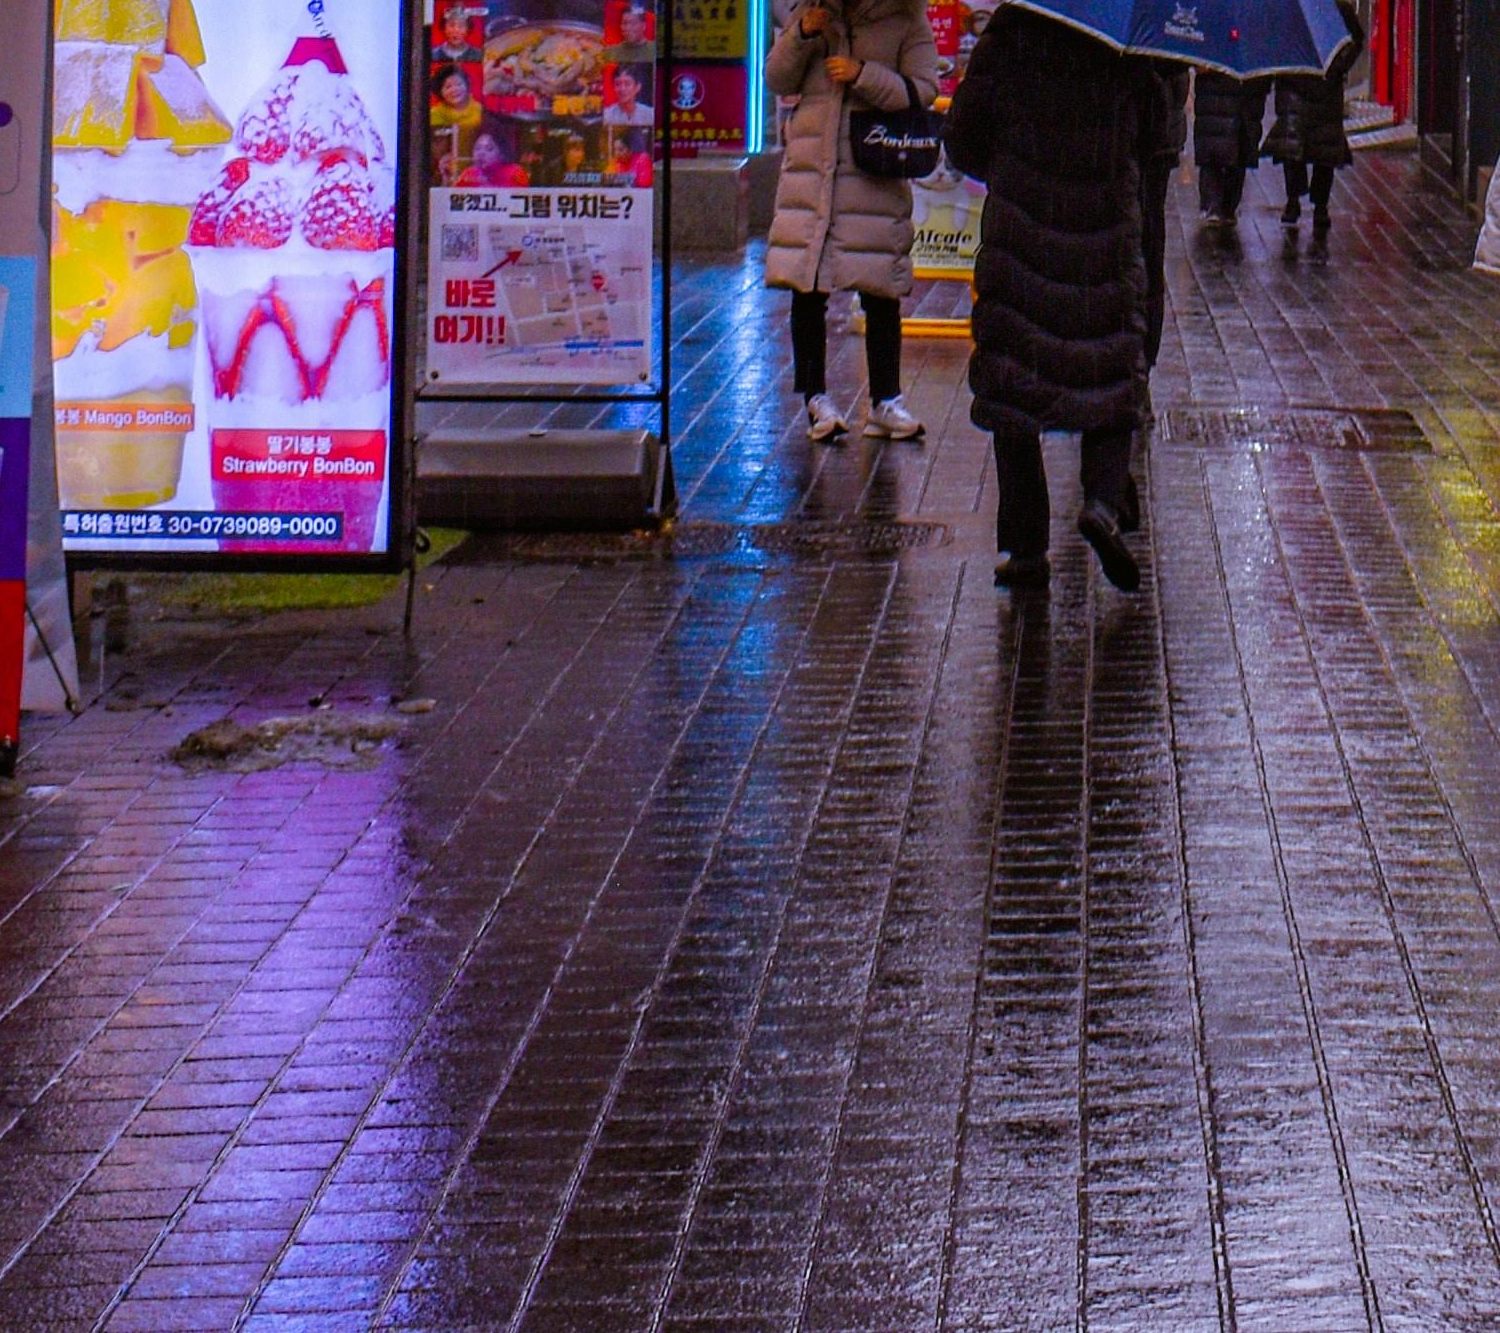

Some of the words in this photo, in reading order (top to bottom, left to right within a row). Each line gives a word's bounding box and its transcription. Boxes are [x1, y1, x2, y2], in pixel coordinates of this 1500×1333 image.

[509, 194, 551, 219] 그럼
[557, 194, 634, 220] 위치는?
[445, 279, 497, 308] 바로
[433, 315, 506, 345] 여기!!
[84, 409, 132, 428] Mango
[136, 409, 192, 427] BonBon
[267, 435, 333, 455] 딸기봉봉
[222, 455, 308, 477] Strawberry
[312, 456, 375, 475] BonBon
[63, 515, 165, 534] 특허출원번호
[168, 517, 337, 535] 30-0739089-0000
